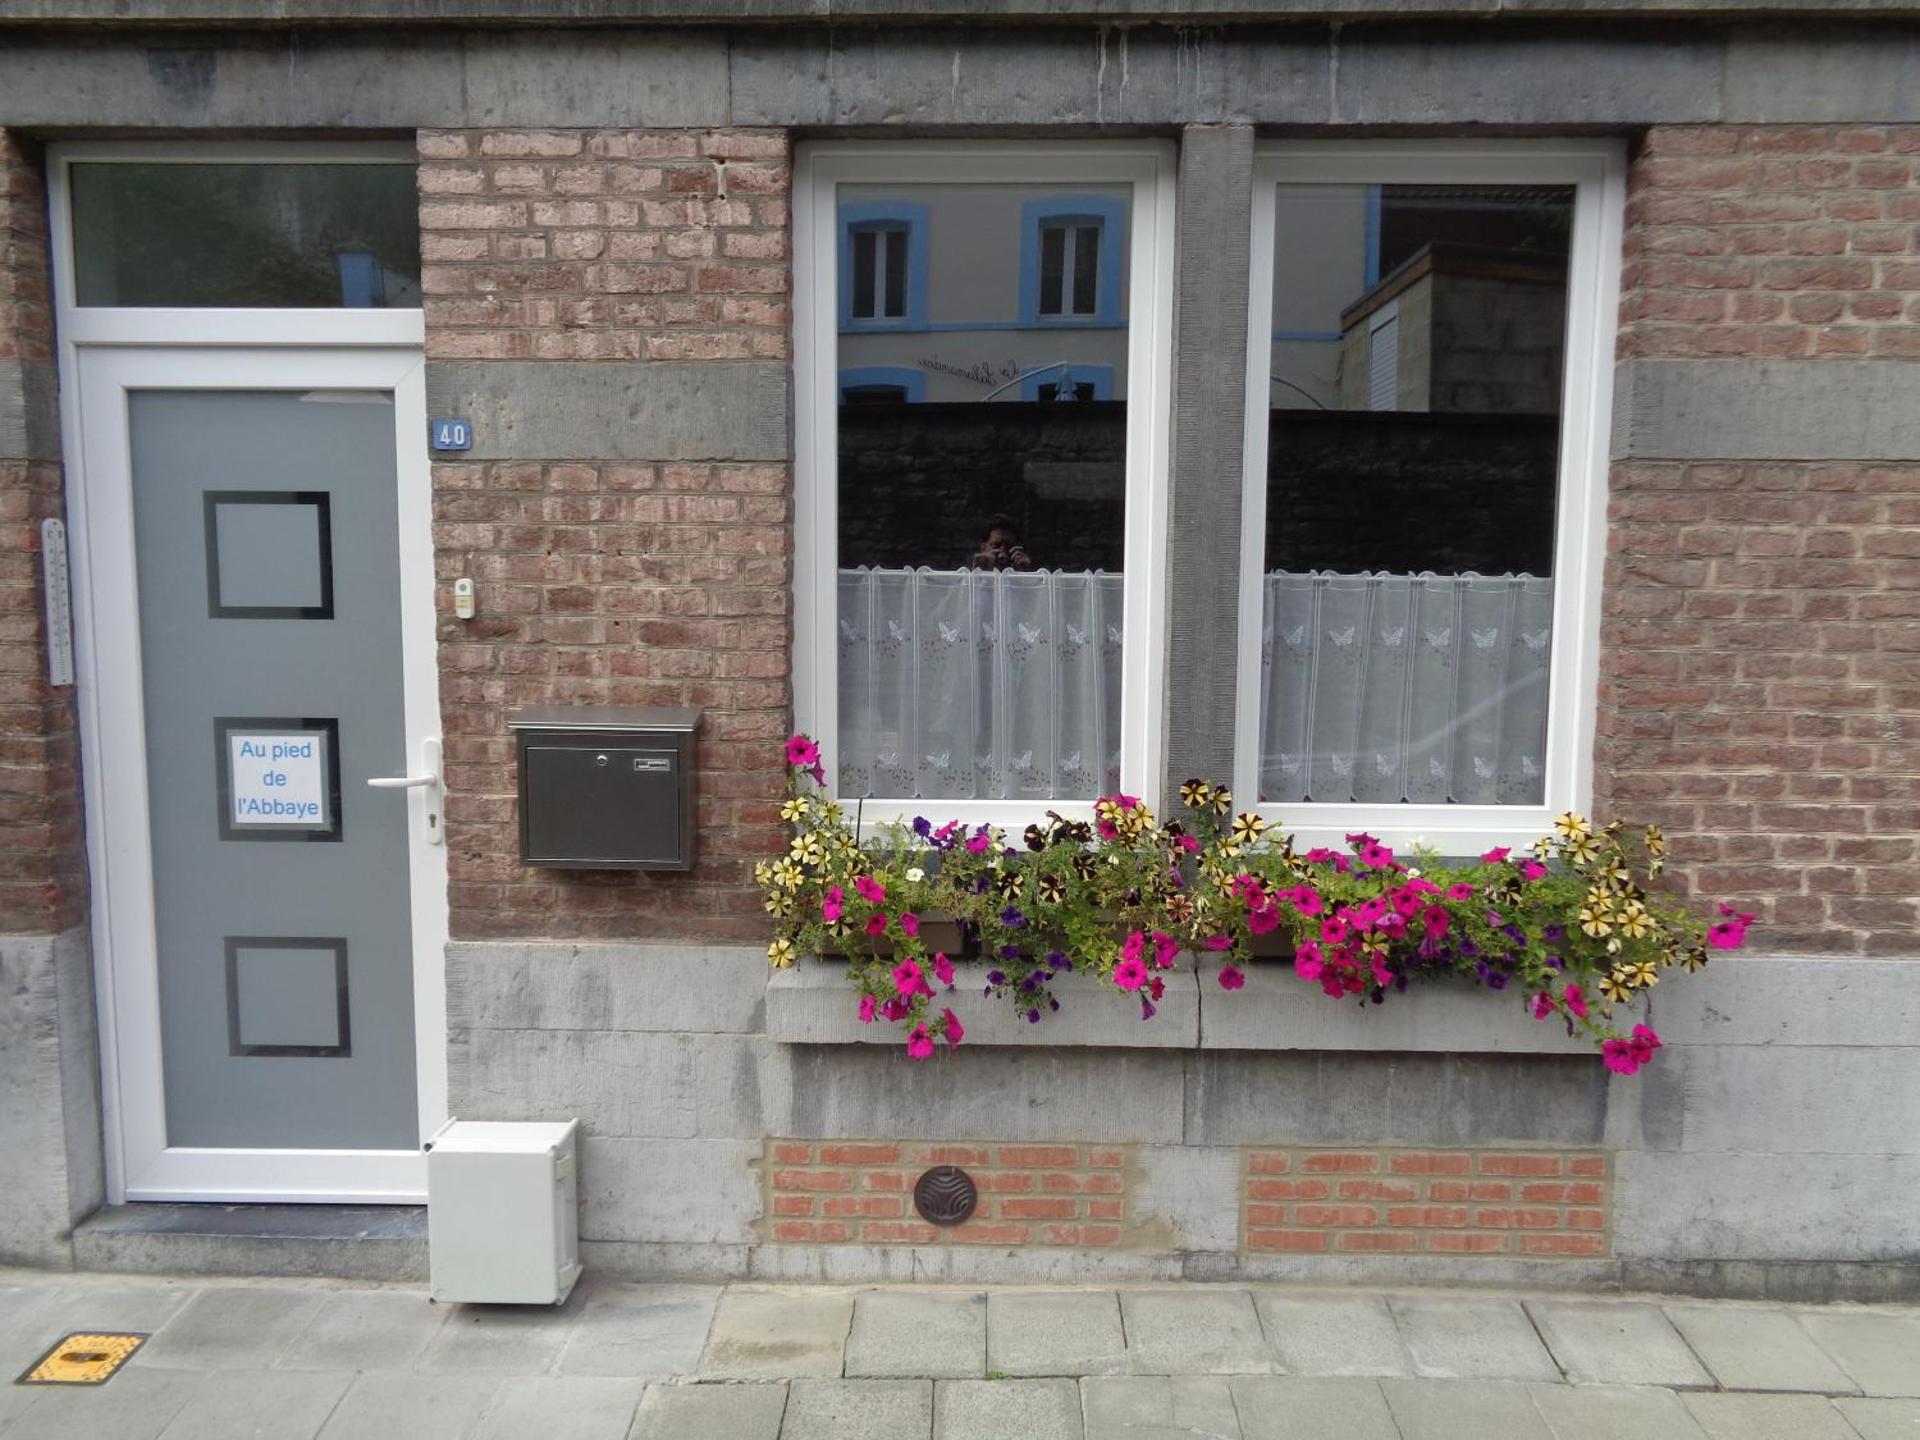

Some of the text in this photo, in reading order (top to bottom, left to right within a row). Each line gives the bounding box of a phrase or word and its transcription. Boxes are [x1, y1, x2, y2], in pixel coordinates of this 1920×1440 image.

[440, 424, 465, 445] 40
[240, 740, 311, 761] Au pied
[263, 770, 287, 786] de
[238, 798, 318, 818] l'Abbaye
